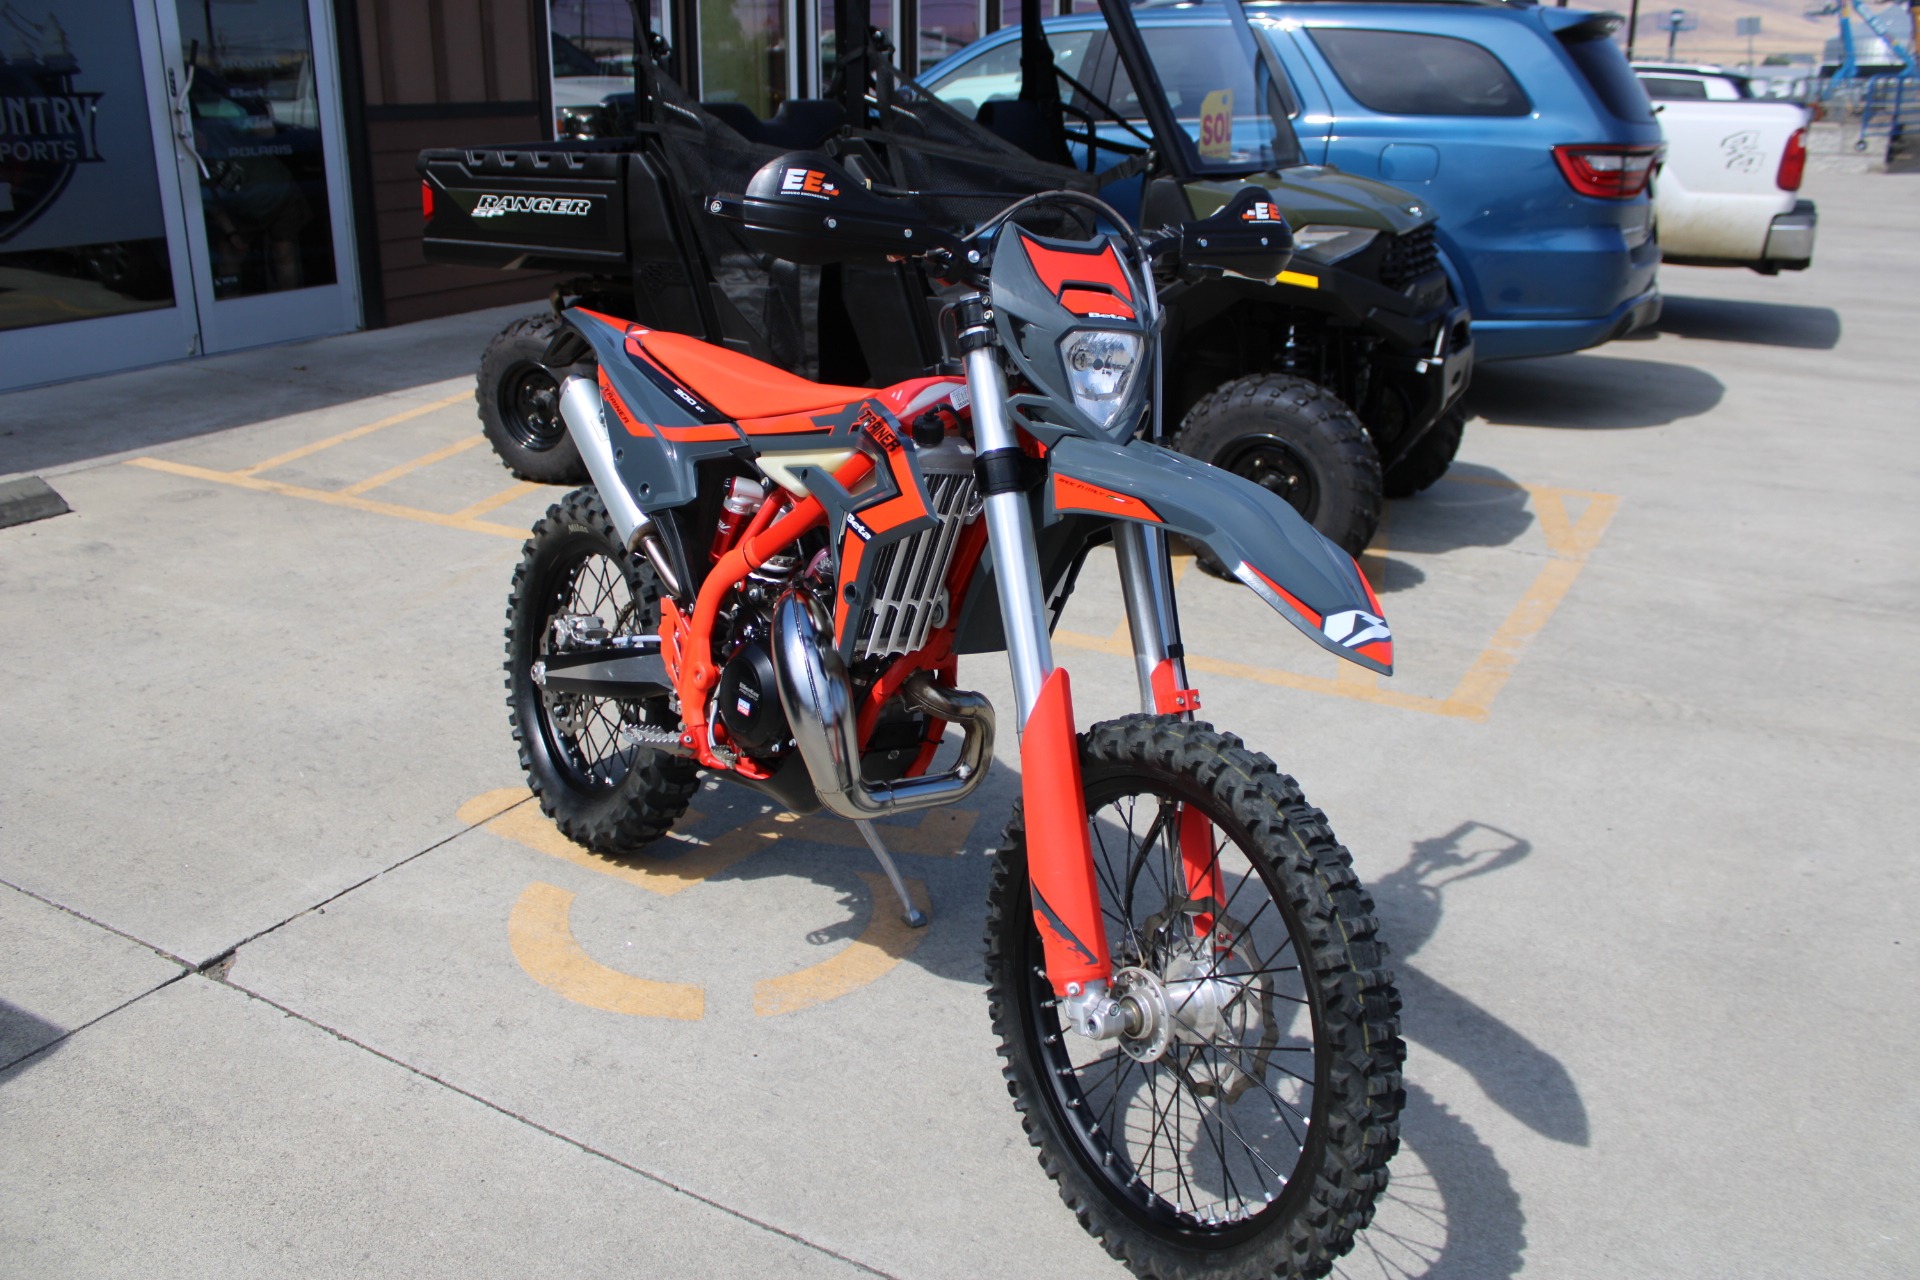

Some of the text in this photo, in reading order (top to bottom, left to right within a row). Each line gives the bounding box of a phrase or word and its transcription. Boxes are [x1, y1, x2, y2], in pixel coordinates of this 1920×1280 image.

[227, 145, 293, 157] POLARIS
[476, 194, 592, 216] RANGER
[1088, 311, 1127, 321] Beta
[673, 387, 698, 406] 300
[846, 512, 872, 541] Beta
